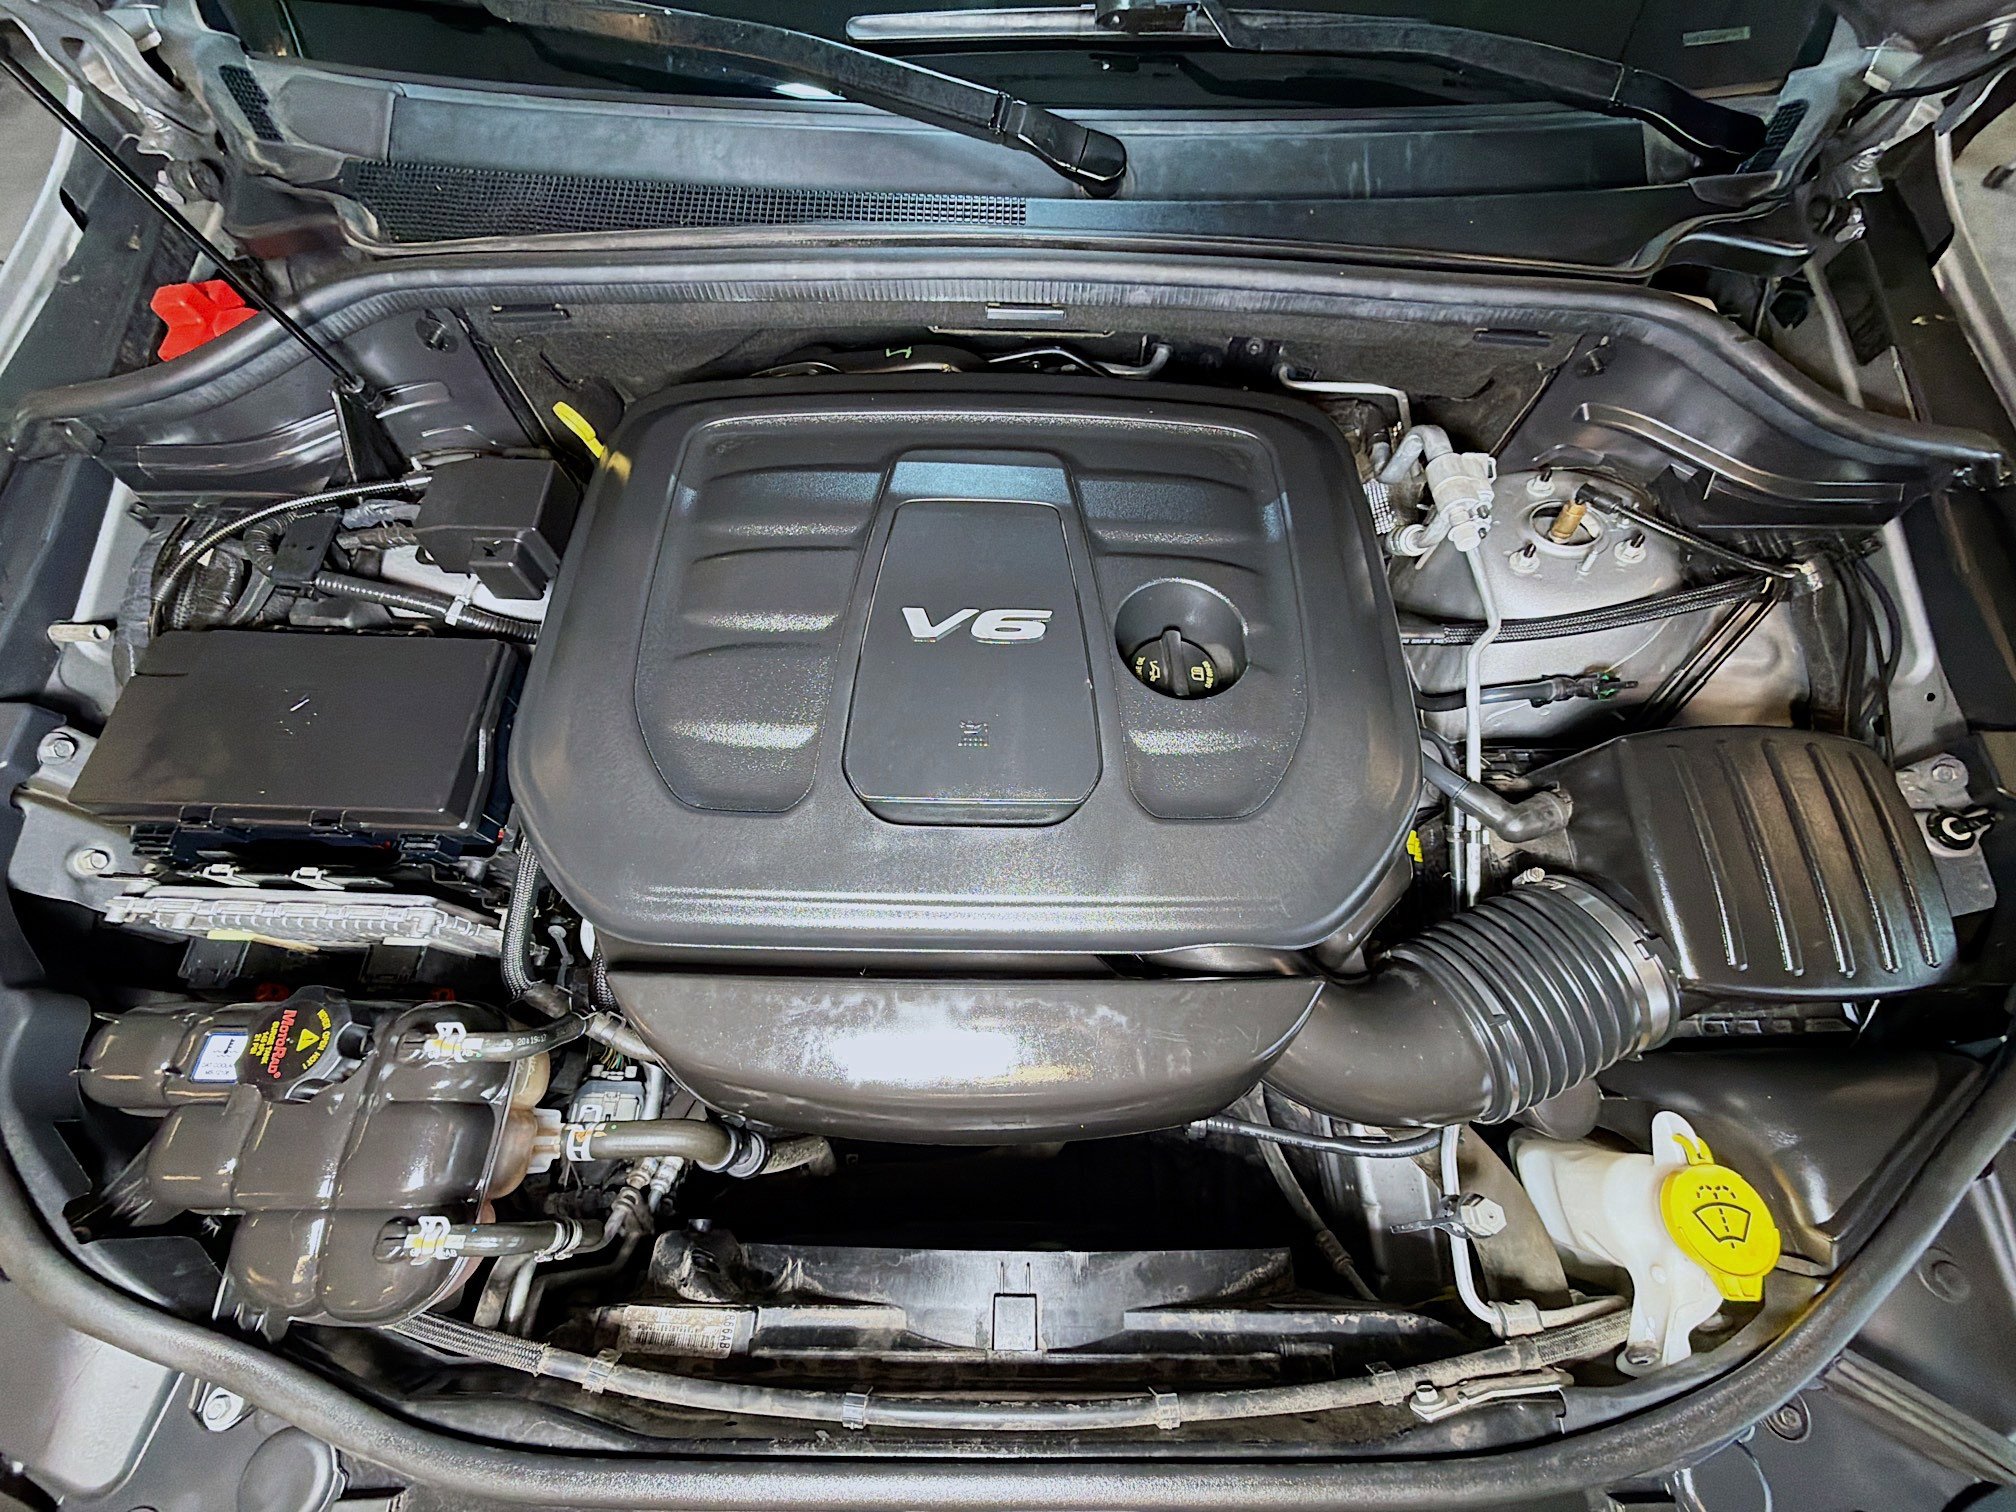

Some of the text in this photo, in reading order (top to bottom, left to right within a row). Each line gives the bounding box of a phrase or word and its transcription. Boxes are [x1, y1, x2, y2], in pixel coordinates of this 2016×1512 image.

[901, 606, 1054, 643] V6
[317, 1030, 331, 1051] OPEN
[306, 1051, 321, 1067] HOT
